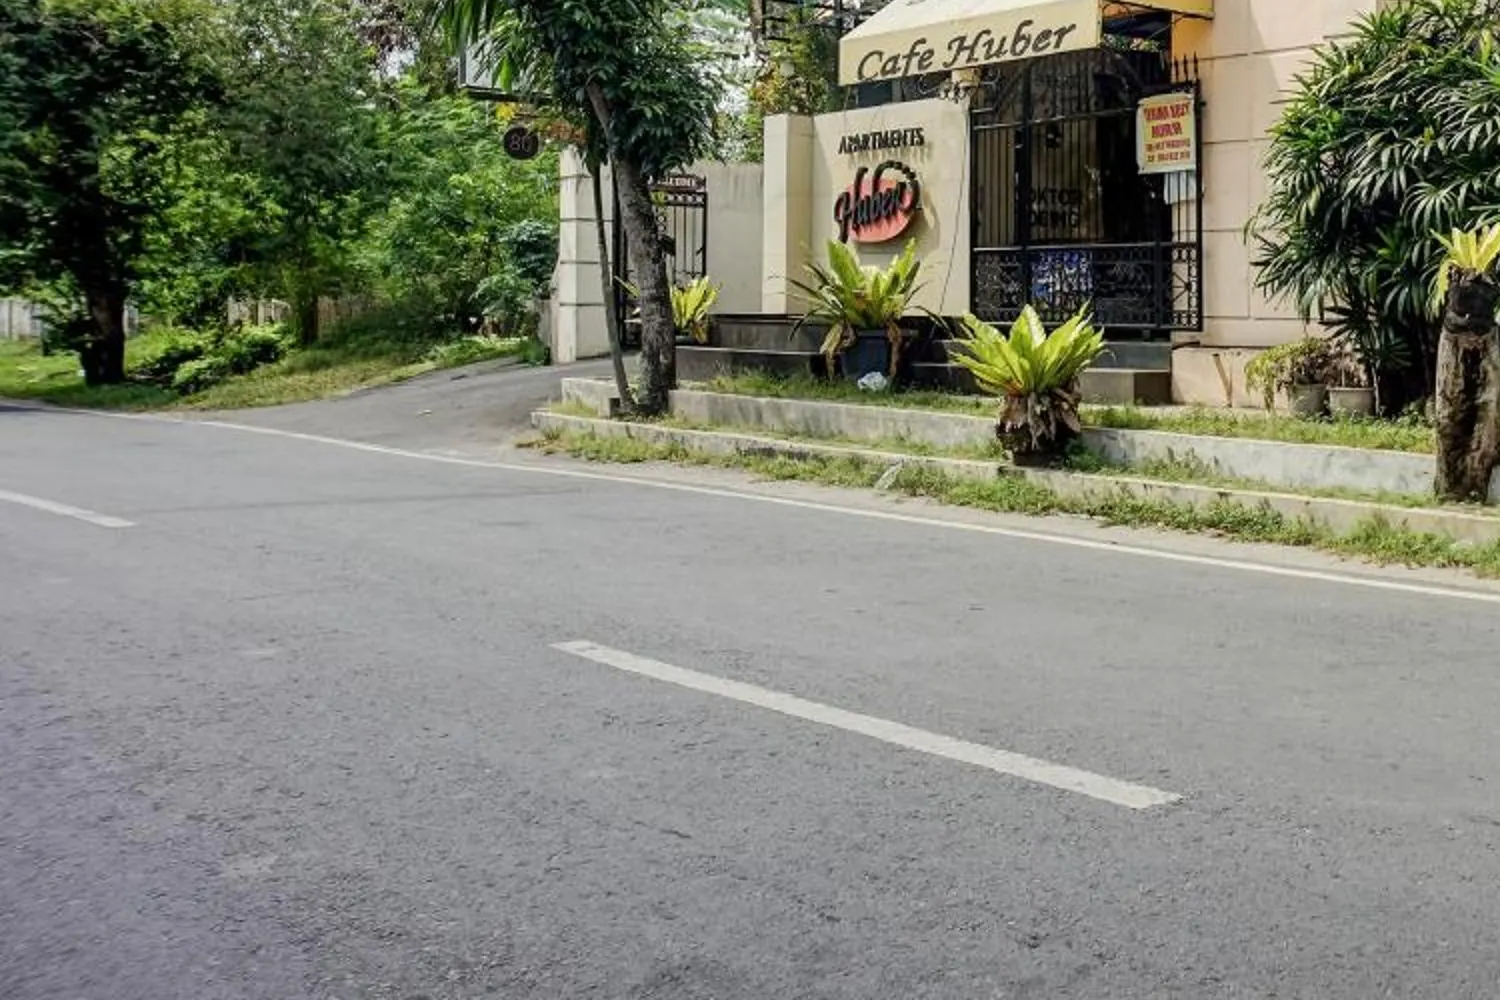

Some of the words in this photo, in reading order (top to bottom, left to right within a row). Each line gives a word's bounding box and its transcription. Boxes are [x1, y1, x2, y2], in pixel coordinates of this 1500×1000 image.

[857, 37, 935, 81] Cafe
[942, 19, 1077, 68] Huber
[838, 127, 925, 154] APARTMENTS
